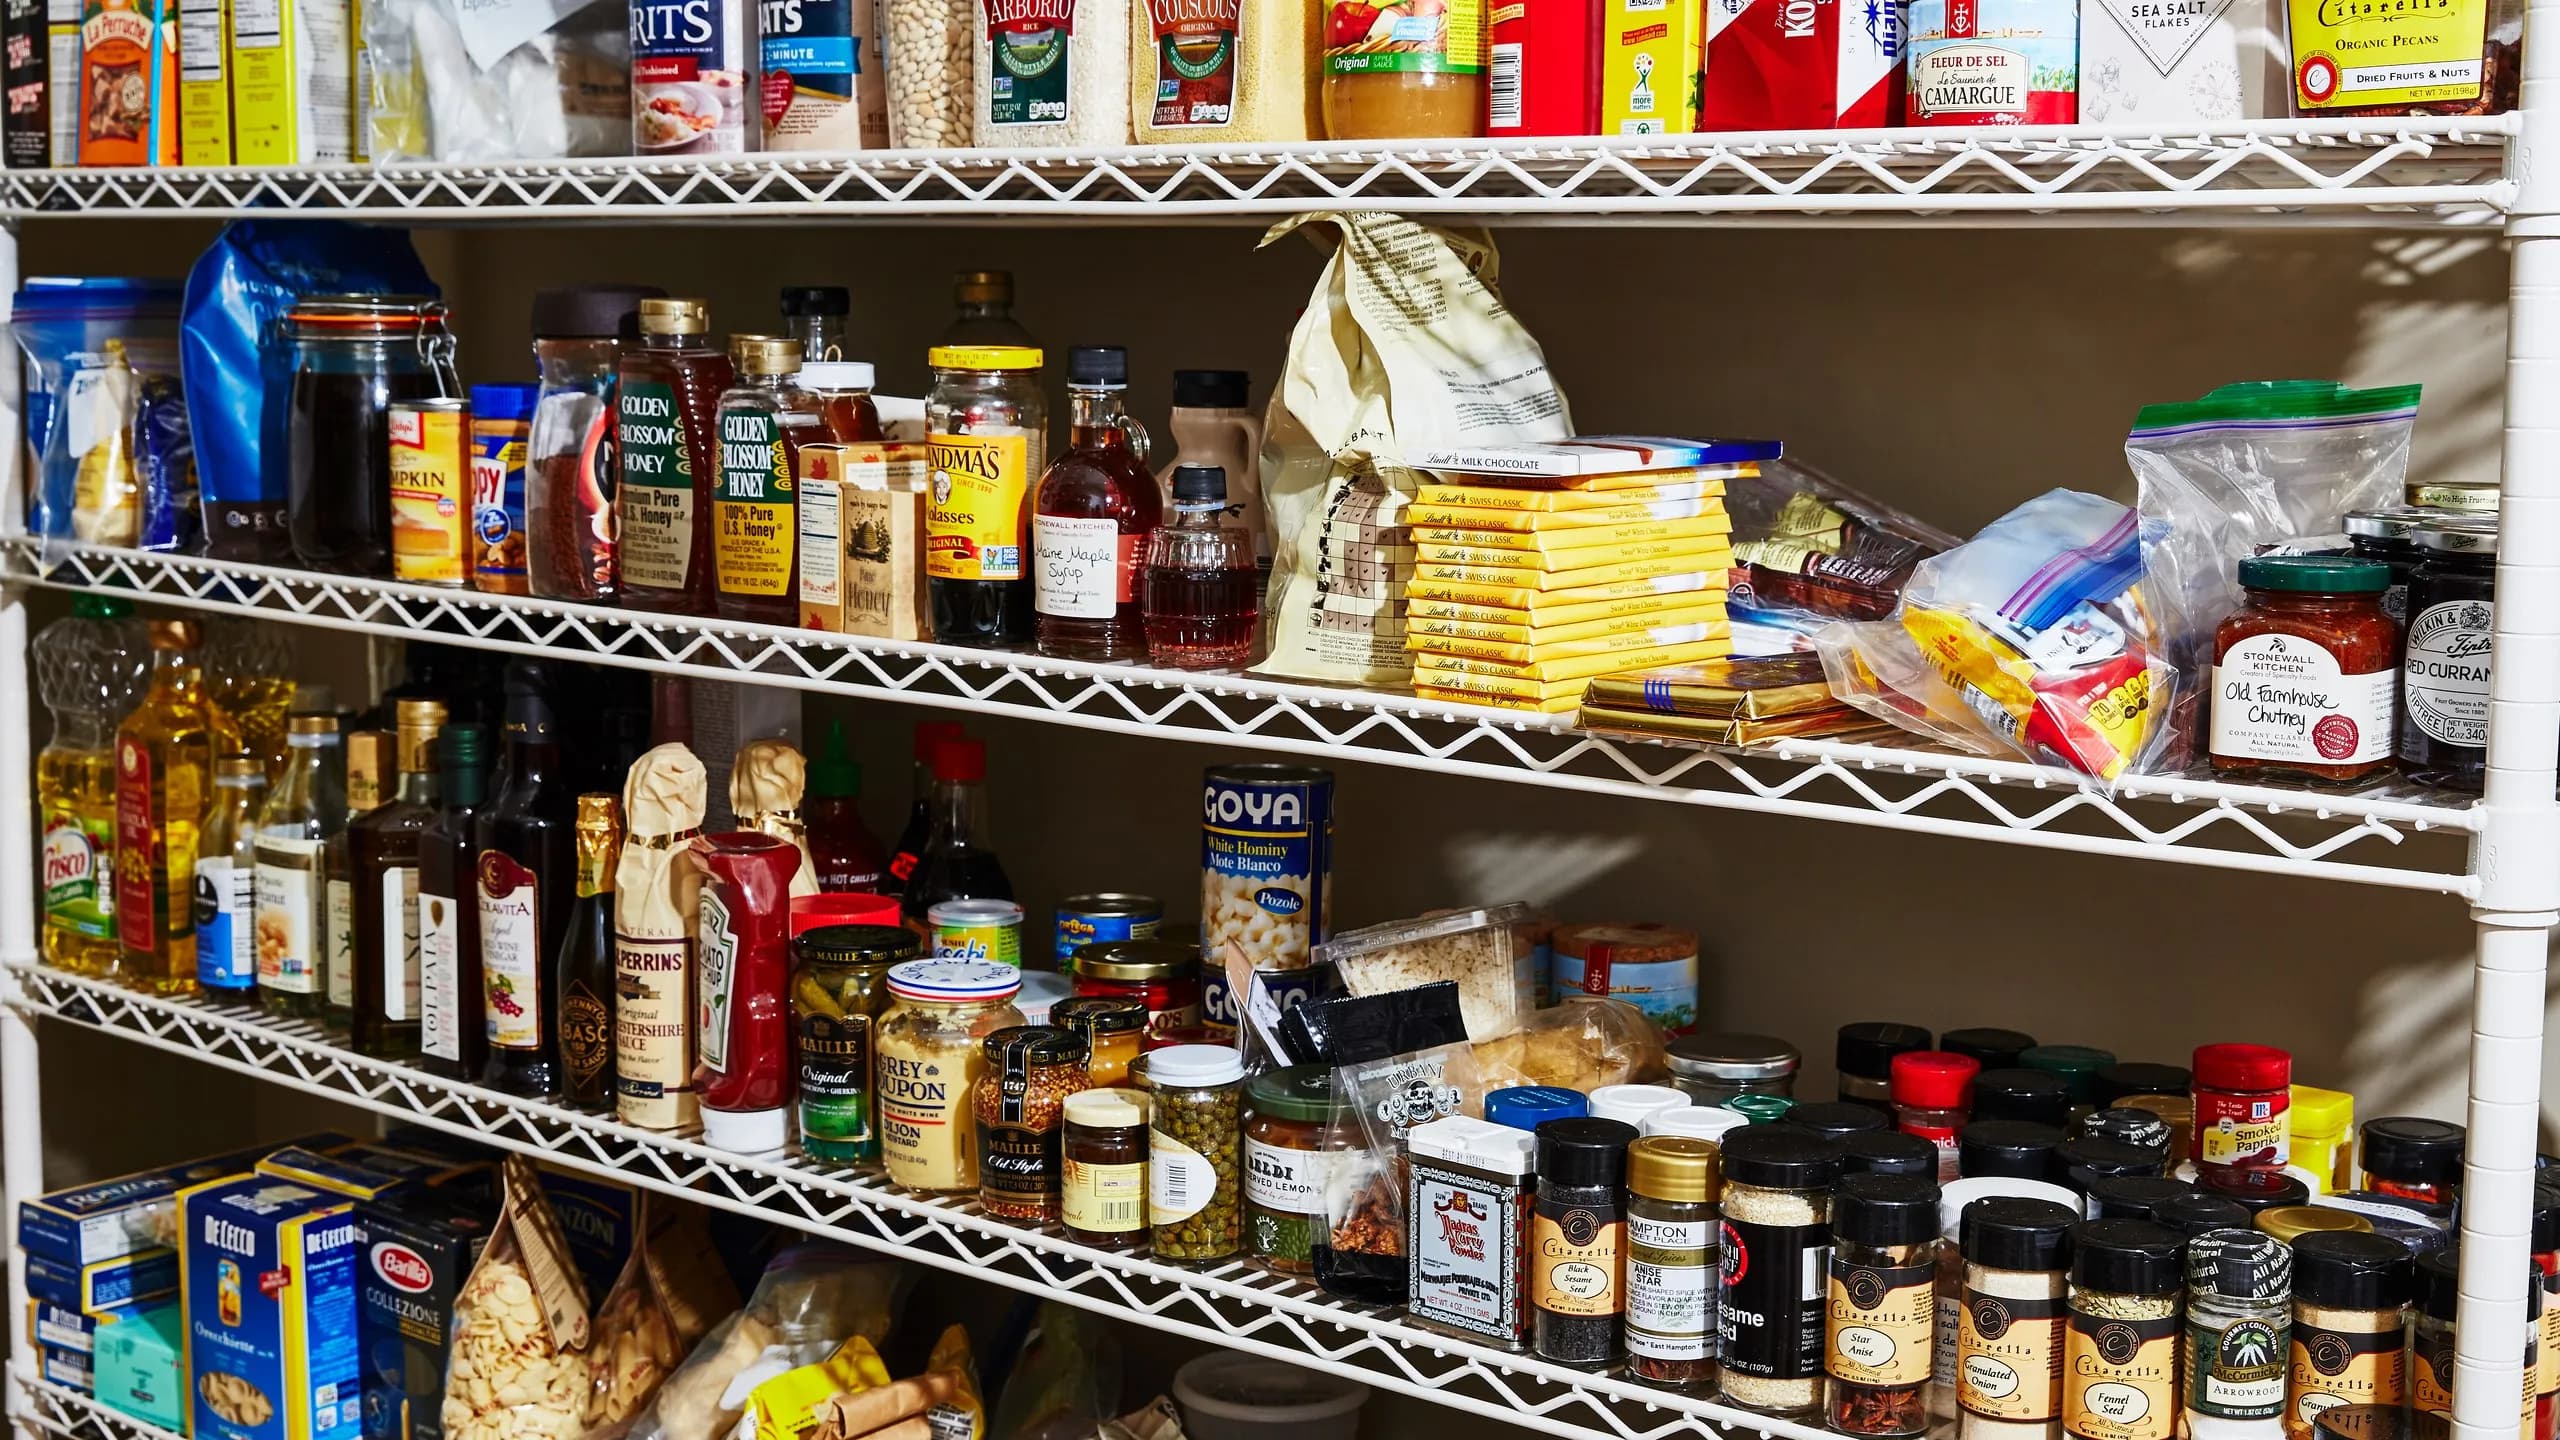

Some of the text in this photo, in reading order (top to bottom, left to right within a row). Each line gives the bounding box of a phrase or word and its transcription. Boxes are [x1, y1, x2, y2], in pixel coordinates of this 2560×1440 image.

[760, 0, 803, 34] ATS
[990, 0, 1071, 25] ARBORIO
[1154, 0, 1238, 25] COUSCOUS
[1774, 2, 1785, 29] Pure
[2131, 1, 2206, 17] SEA SALT
[87, 12, 148, 43] La Perruche
[631, 0, 713, 46] RITS
[1022, 23, 1040, 31] RICE
[1180, 23, 1216, 32] ORIGINAL
[2145, 17, 2190, 28] FLAKES
[2336, 34, 2439, 51] ORGANIC PECANS
[1335, 56, 1370, 71] Original
[1931, 55, 2008, 69] FLEUR DE SEL
[1937, 71, 1997, 85] Le Saunier de
[2356, 68, 2470, 83] DRIED FRUITS & NUTS
[1632, 97, 1652, 105] more
[1925, 86, 2015, 106] CAMARGUE
[2409, 88, 2437, 97] NET WT
[622, 396, 669, 417] GOLDEN
[621, 425, 676, 445] BLOSSOM
[725, 416, 768, 441] GOLDEN
[624, 452, 665, 473] HONEY
[723, 444, 773, 469] BLOSSOM
[1426, 453, 1539, 470] Lindt MILK CHOCOLATE
[391, 471, 446, 488] MPKIN
[729, 473, 765, 497] HONEY
[654, 489, 680, 507] Pure
[1435, 492, 1524, 508] Lindt SWISS CLASSIC
[641, 508, 672, 527] Honey
[724, 504, 774, 521] 100% Pure
[724, 520, 775, 539] U.S. Honey
[1073, 522, 1113, 530] KITCHEN
[1430, 529, 1514, 544] Lindt SWISS CLASSIC
[1067, 545, 1113, 568] Maple
[1436, 549, 1522, 564] Lindt SWISS CLASSIC
[1048, 562, 1084, 586] Syrup
[1433, 568, 1517, 584] Lindt SWISS CLASSIC
[1426, 605, 1510, 622] Lindt SWISS CLASSIC
[1424, 622, 1507, 640] Lindt SWISS CLASSIC
[2411, 611, 2456, 646] WILKIN &
[2243, 652, 2315, 664] STONEWALL
[2253, 662, 2304, 673] KITCHEN
[2407, 658, 2426, 676] RED
[1431, 675, 1516, 694] Lindt SWISS CLASSIC
[2225, 681, 2340, 709] Old Farmhouse
[2093, 702, 2110, 716] 70
[2408, 688, 2441, 731] TIPTREE
[2248, 705, 2306, 735] Chutney
[2448, 719, 2488, 729] NET WEIGHT
[2228, 729, 2270, 740] COMPANY
[2267, 740, 2300, 749] NATURAL
[1204, 786, 1301, 826] GOYA
[1208, 836, 1289, 859] White Hominy
[1210, 852, 1282, 873] Mote Blanco
[830, 873, 848, 885] HOT
[479, 902, 531, 916] OLAVITA
[1260, 891, 1301, 911] Pozole
[816, 951, 859, 962] MAILLE
[425, 930, 438, 1049] VOLPAIA
[621, 1009, 658, 1021] Original
[617, 1023, 685, 1038] ESTERSHIRE
[801, 1064, 852, 1084] Original
[879, 1053, 923, 1079] GREY
[1003, 1080, 1026, 1091] 1747
[2217, 1100, 2243, 1110] The Taste
[2254, 1102, 2270, 1117] Mc
[884, 1118, 921, 1139] DIJON
[2235, 1121, 2282, 1142] Smoked
[886, 1133, 919, 1148] MUSTARD
[989, 1141, 1042, 1155] MAILLE
[2236, 1134, 2281, 1153] Paprika
[988, 1155, 1044, 1175] Old Style
[1435, 1192, 1446, 1200] SUN
[1435, 1211, 1479, 1241] Madras
[220, 1219, 256, 1257] CECCO
[1455, 1230, 1485, 1251] Curry
[1653, 1236, 1691, 1245] PLACE
[1448, 1237, 1486, 1263] Powder
[1543, 1237, 1617, 1258] Citarella
[384, 1253, 428, 1284] Barilla
[1567, 1264, 1589, 1273] Black
[1634, 1264, 1662, 1277] ANISE
[2252, 1265, 2269, 1281] All
[1564, 1274, 1592, 1284] Sesame
[1636, 1274, 1662, 1286] STAR
[1569, 1285, 1587, 1294] Seed
[2252, 1283, 2268, 1299] All
[366, 1286, 442, 1328] COLLEZIONE
[1426, 1295, 1439, 1305] NET
[1718, 1301, 1765, 1327] esame
[1831, 1299, 1907, 1324] Citarella
[1850, 1333, 1872, 1344] Star
[1960, 1327, 2032, 1355] Citarella
[2222, 1321, 2278, 1351] GOURMET COLLECTION
[1666, 1343, 1697, 1351] Hampton
[1848, 1345, 1875, 1358] Anise
[1749, 1362, 1773, 1374] (107g)
[1964, 1360, 2012, 1381] Granulated
[2075, 1354, 2161, 1380] Citarella
[2214, 1366, 2277, 1382] McCormick
[1971, 1376, 1998, 1391] Onion
[2213, 1384, 2281, 1397] ARROWROOT
[2097, 1391, 2130, 1405] Fennel
[2101, 1403, 2125, 1416] Seed
